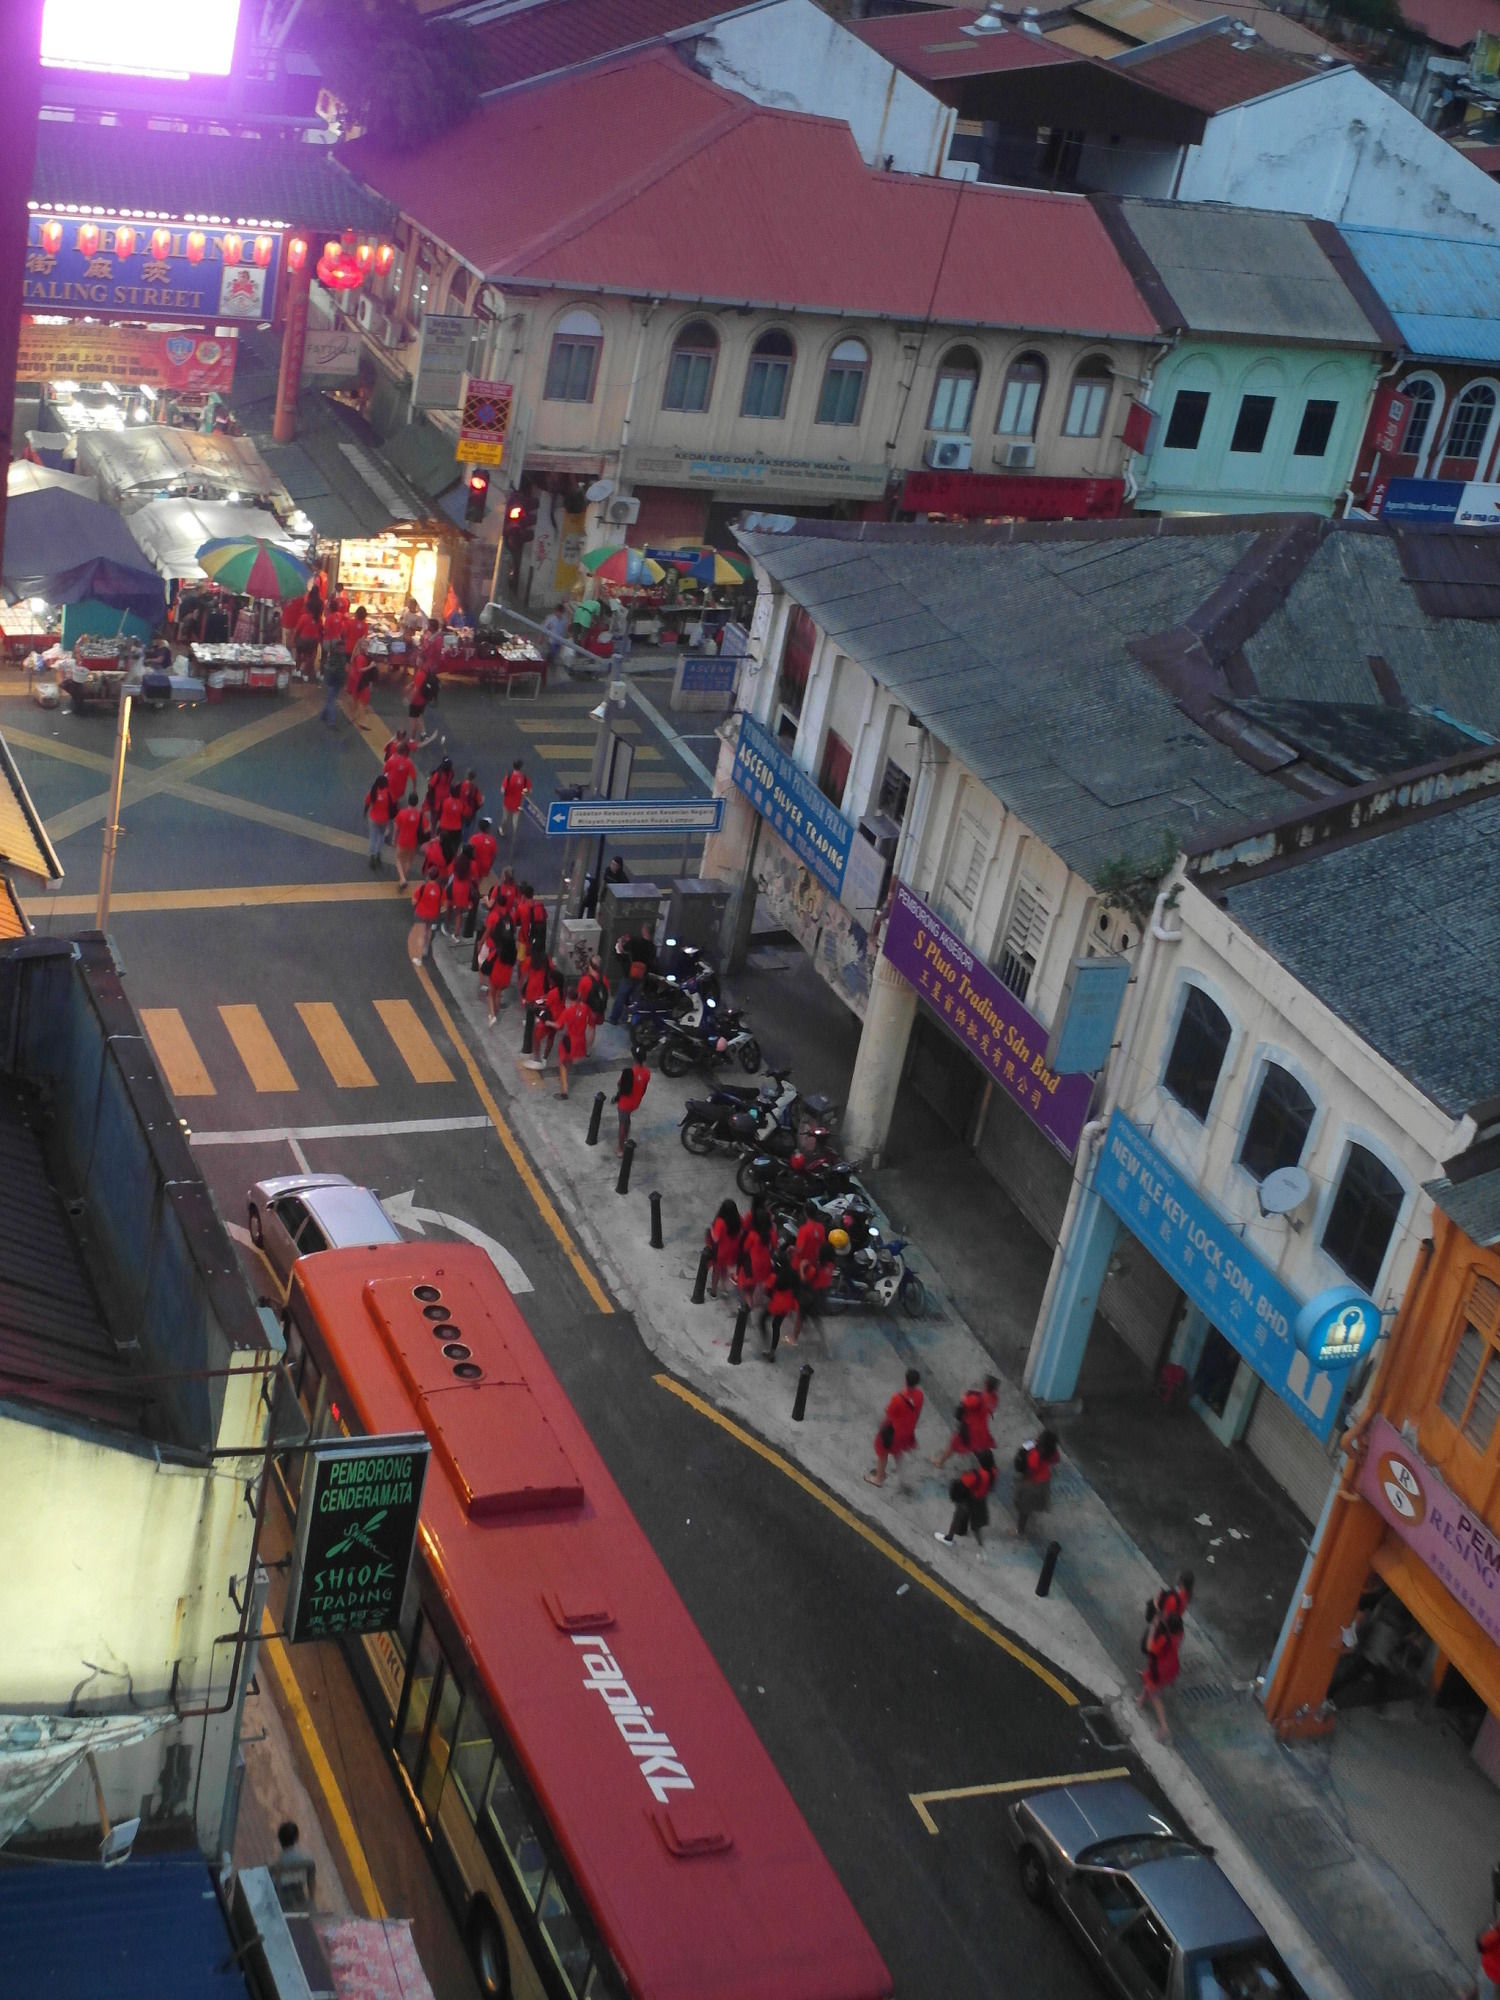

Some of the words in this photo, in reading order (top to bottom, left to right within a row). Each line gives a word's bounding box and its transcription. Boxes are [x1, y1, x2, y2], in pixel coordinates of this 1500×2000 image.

[114, 285, 205, 308] STREET
[674, 452, 707, 462] KEDAI
[709, 454, 731, 464] BEG
[733, 456, 755, 466] DAN
[758, 458, 811, 469] AKSESORI
[813, 462, 851, 472] WANITA
[737, 742, 774, 790] ASCEND
[773, 785, 804, 827] SILVER
[805, 821, 844, 870] TRADING
[897, 887, 940, 938] PEMBORONG
[939, 928, 975, 972] AKSESORI
[913, 929, 925, 951] S
[924, 941, 957, 984] Pluto
[956, 973, 1006, 1039] Trading
[1003, 1025, 1031, 1063] Sdn
[1111, 1136, 1141, 1178] NEW
[1138, 1167, 1163, 1205] KLE
[1161, 1191, 1189, 1229] KEY
[1187, 1219, 1224, 1270] LOCK
[1222, 1258, 1254, 1307] SDN.
[1255, 1294, 1290, 1344] BHD.
[329, 1456, 413, 1486] PEMBORONG
[320, 1482, 413, 1513] CENDERAMATA
[1430, 1506, 1496, 1590] RESING
[313, 1561, 396, 1593] SHIOK
[310, 1587, 393, 1612] TRADING
